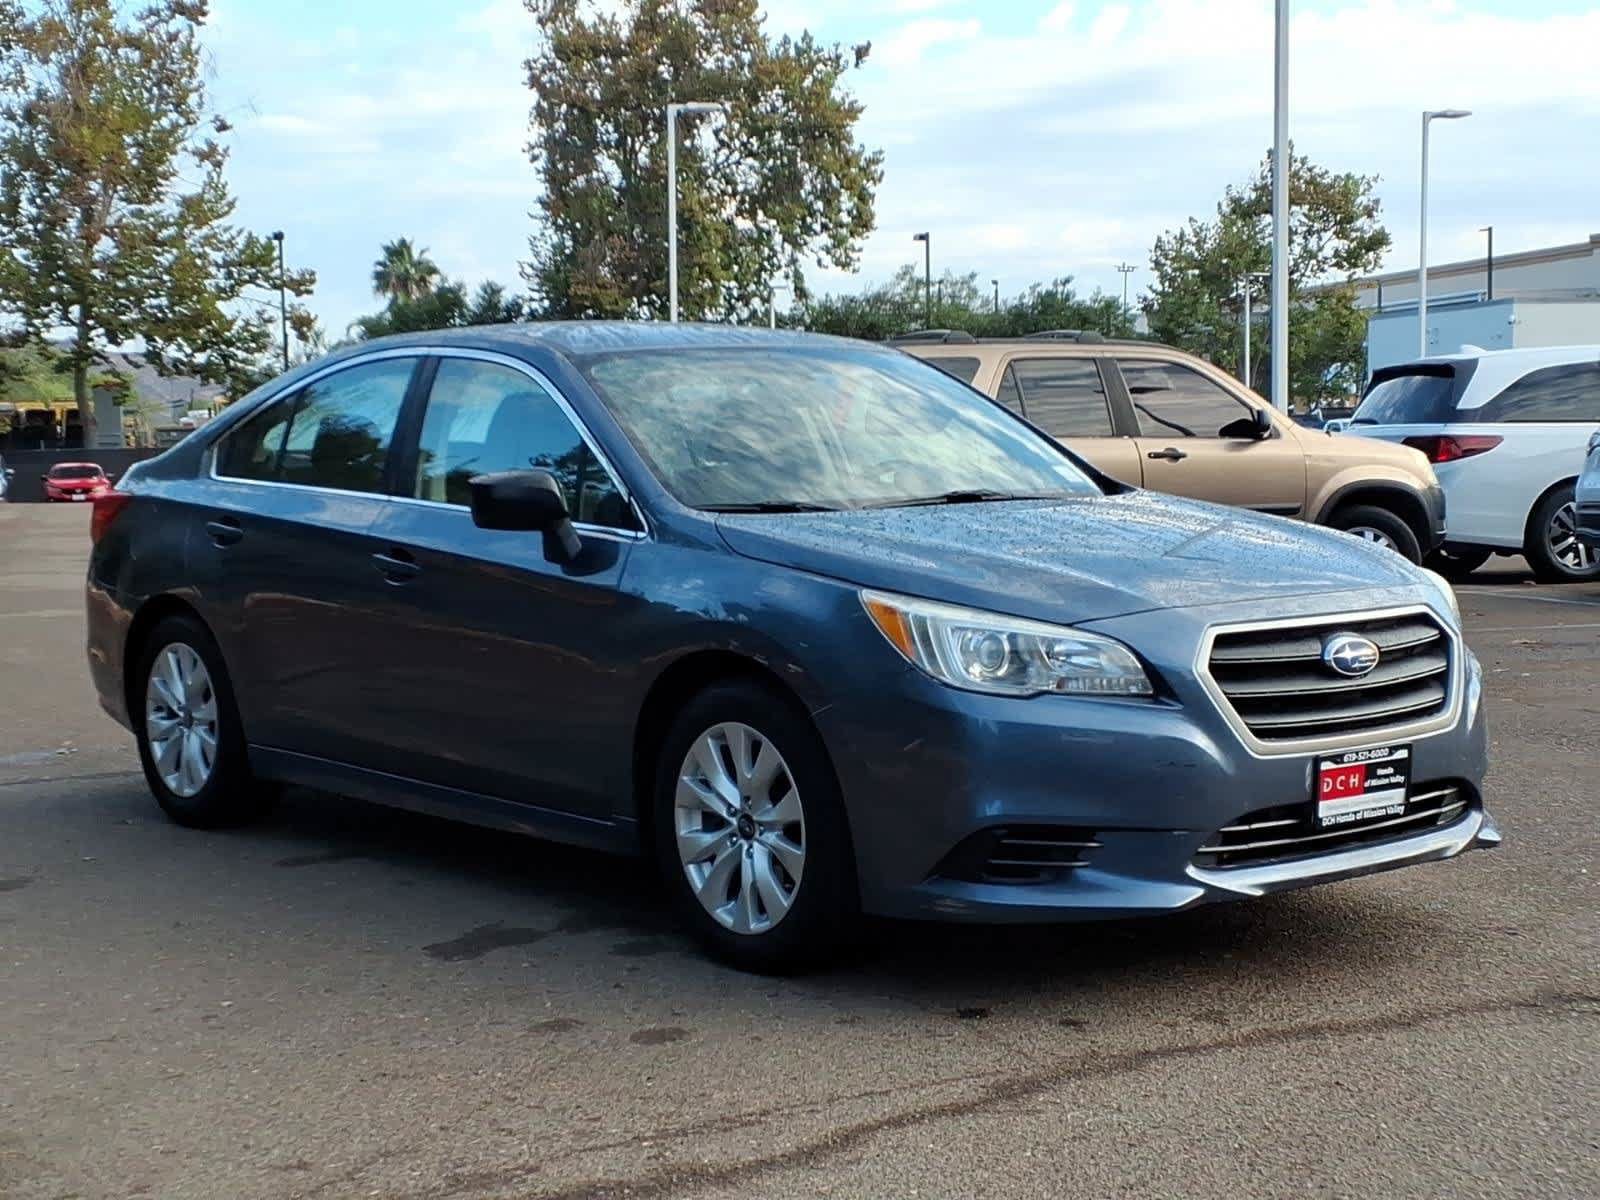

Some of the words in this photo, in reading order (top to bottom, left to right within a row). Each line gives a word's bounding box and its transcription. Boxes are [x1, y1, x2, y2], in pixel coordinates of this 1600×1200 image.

[1323, 772, 1360, 793] DCH
[1321, 817, 1335, 827] DCH
[1386, 805, 1405, 815] Valley
